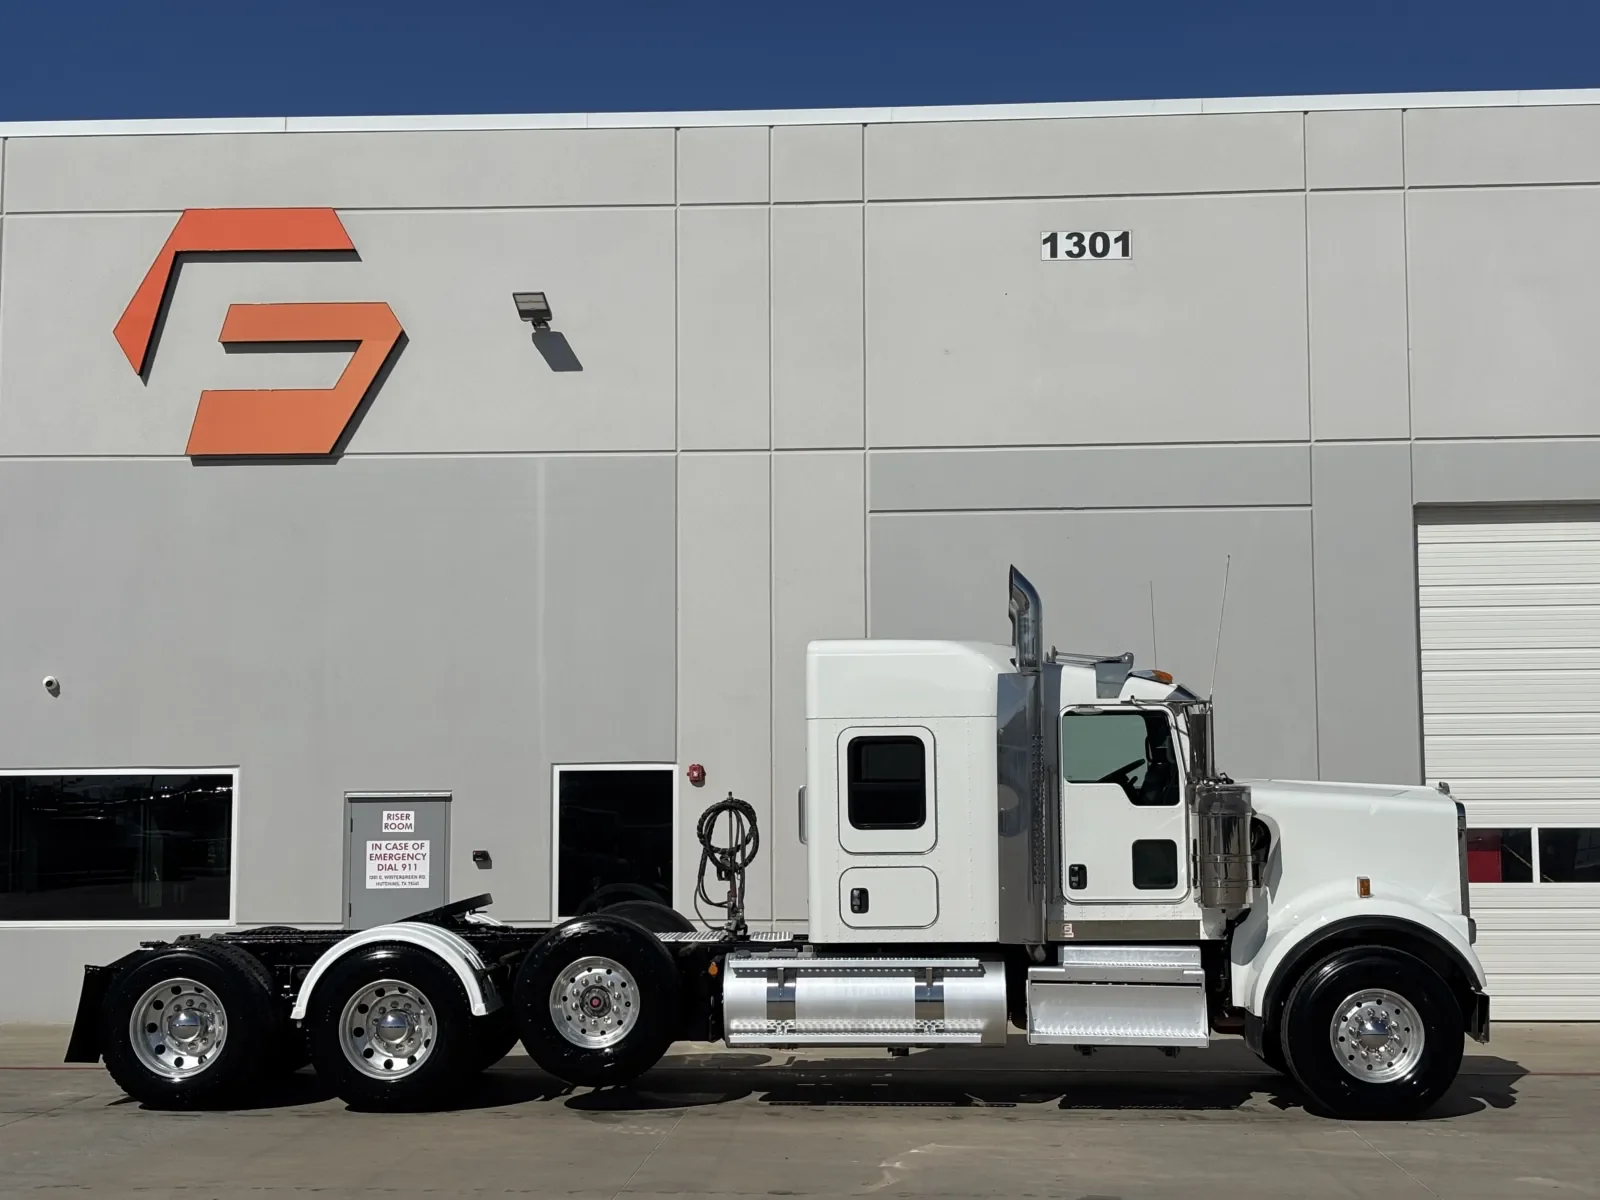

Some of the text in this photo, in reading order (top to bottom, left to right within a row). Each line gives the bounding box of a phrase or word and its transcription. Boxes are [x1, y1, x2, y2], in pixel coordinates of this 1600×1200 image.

[1042, 231, 1130, 259] 1301
[386, 813, 411, 821] RISER
[384, 822, 413, 831] ROOM
[371, 842, 425, 851] IN CASE OF
[369, 853, 427, 861] EMERGENCY
[377, 863, 418, 872] DIAL 911
